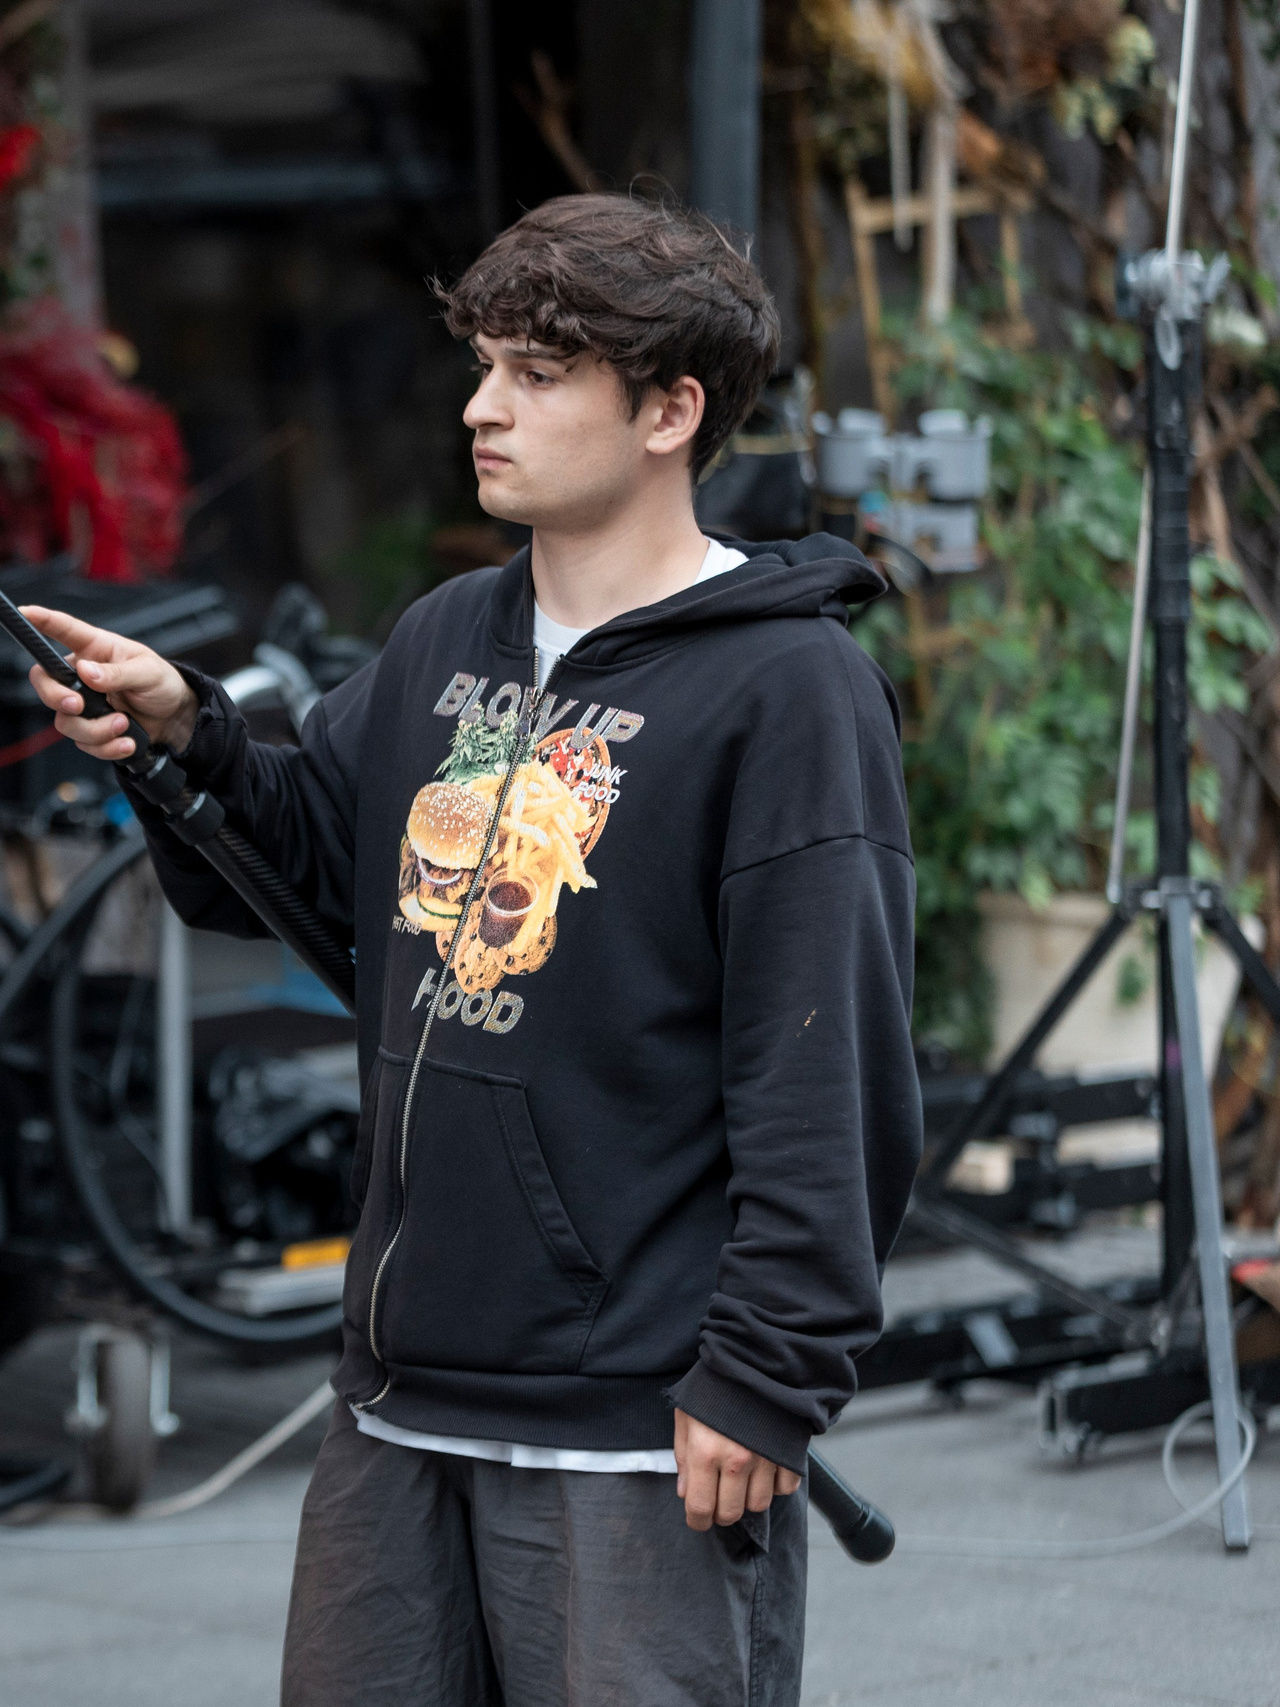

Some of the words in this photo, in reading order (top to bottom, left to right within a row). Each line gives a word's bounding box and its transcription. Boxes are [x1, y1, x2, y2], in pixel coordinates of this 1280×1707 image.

[433, 672, 580, 741] BLOW
[570, 702, 645, 750] UP
[571, 781, 621, 804] FOOD
[583, 763, 628, 785] JUNK
[411, 966, 524, 1035] HOOD
